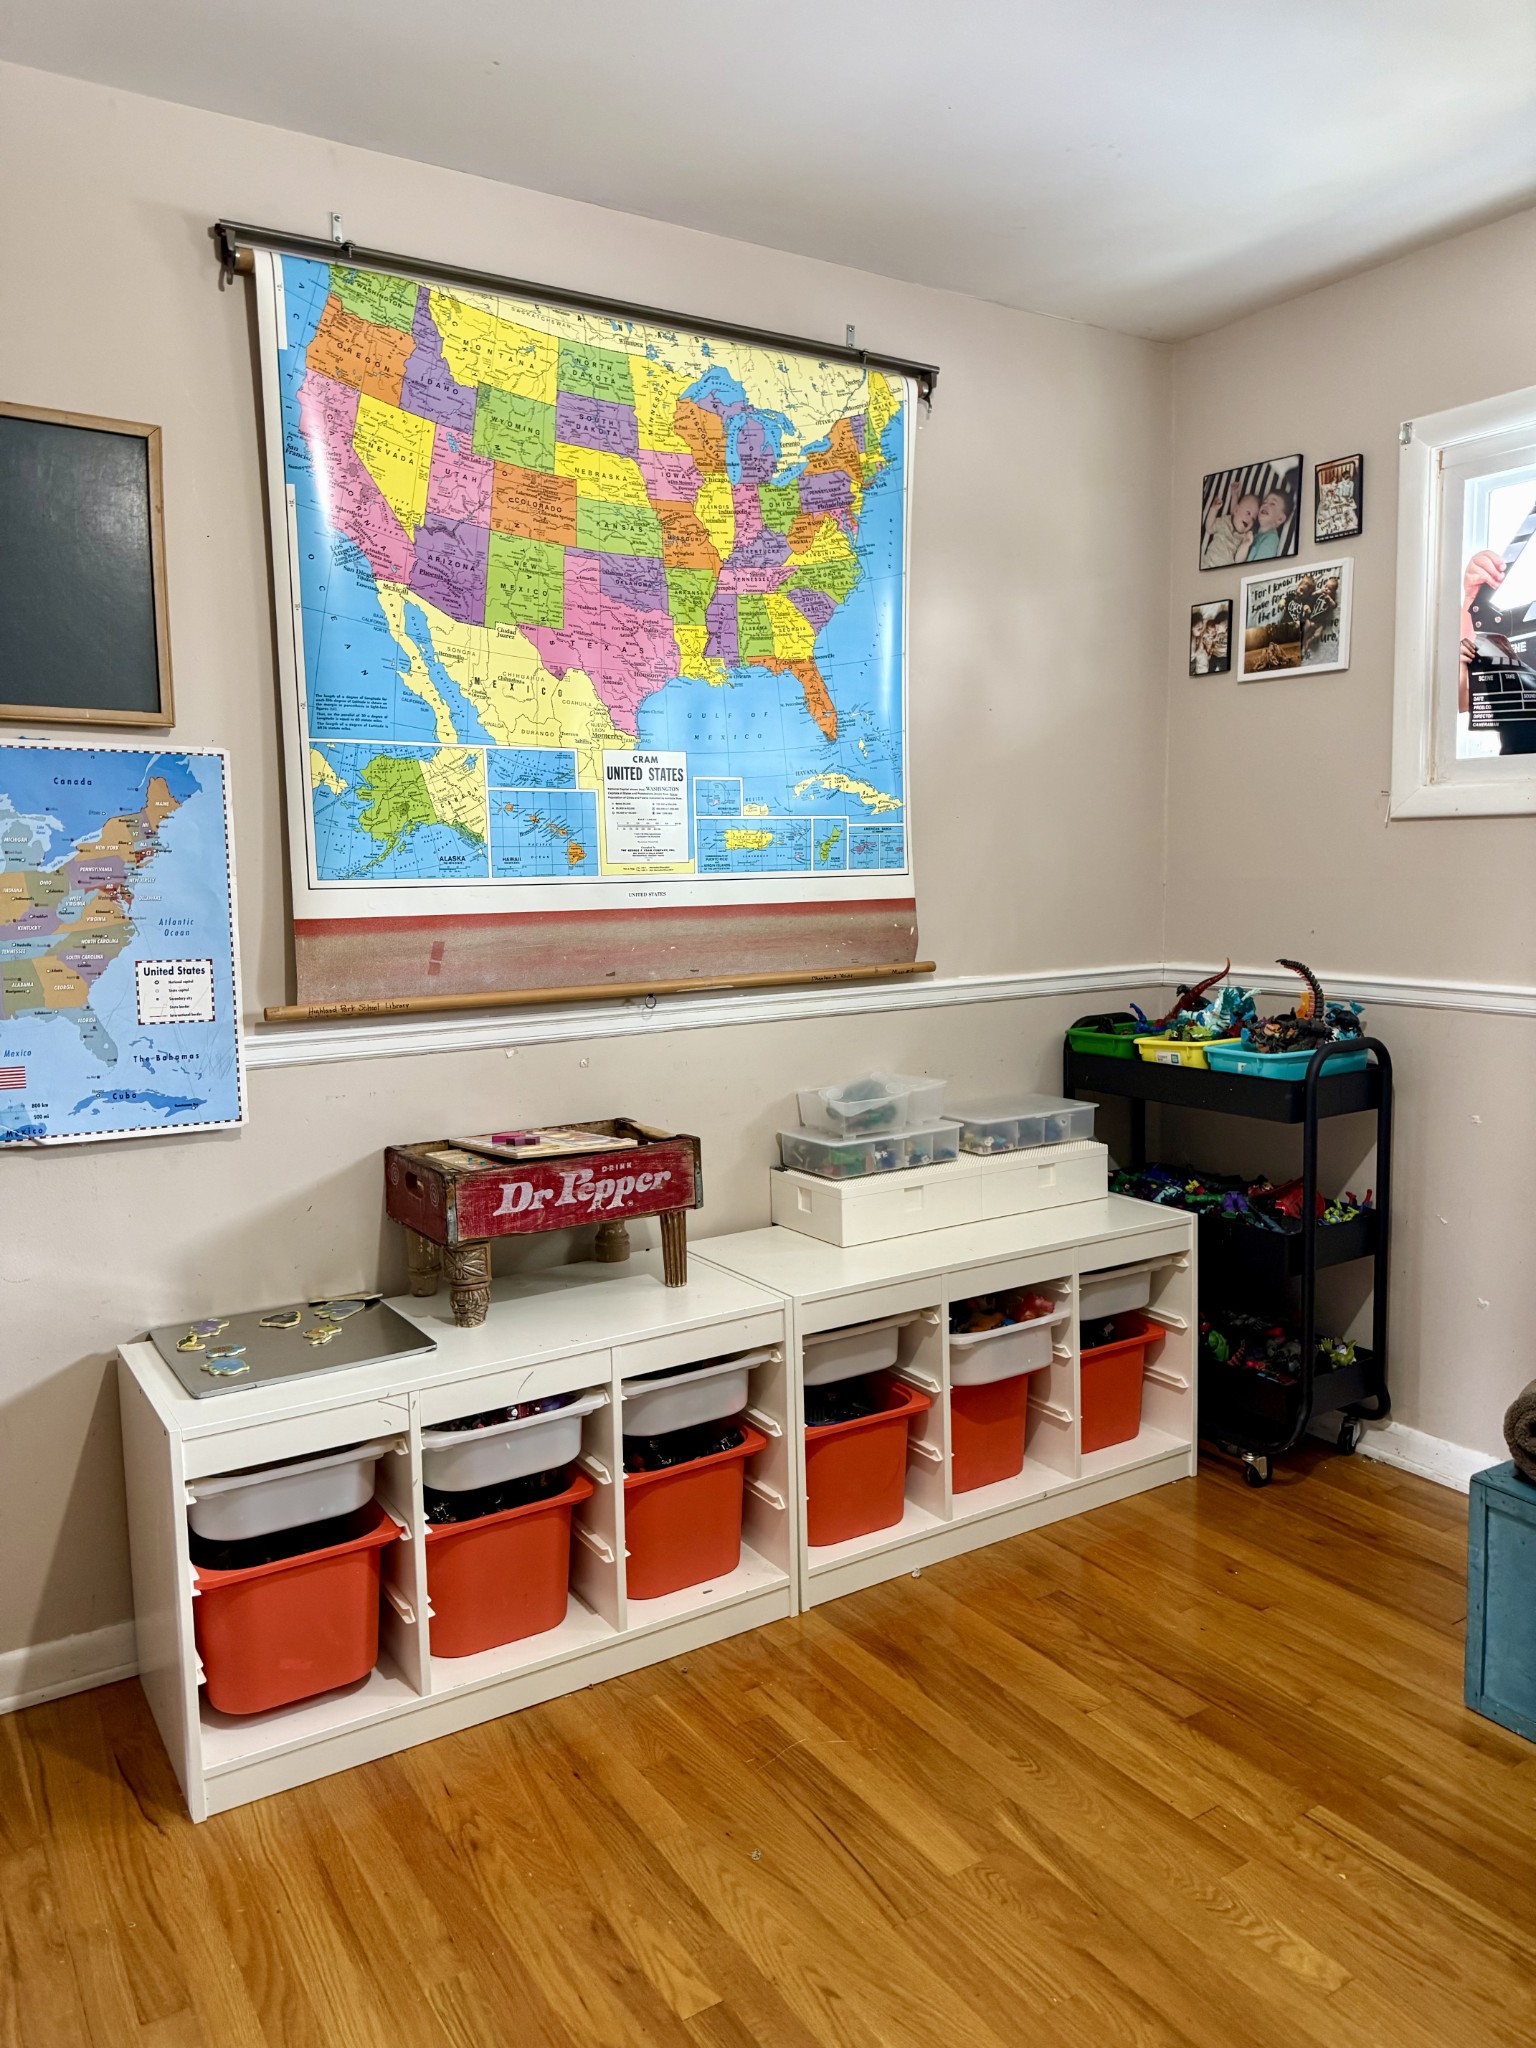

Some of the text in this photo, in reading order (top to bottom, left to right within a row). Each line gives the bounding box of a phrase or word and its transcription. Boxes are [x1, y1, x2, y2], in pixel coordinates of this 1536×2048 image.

[356, 282, 403, 308] WASHINGTON
[511, 306, 572, 329] SASKATCHEWAN
[337, 342, 390, 373] OREGON
[463, 339, 534, 369] MONTANA
[576, 357, 613, 372] NORTH
[572, 370, 616, 385] DAKOTA
[420, 375, 460, 396] IDAHO
[648, 380, 670, 436] MINNESOTA
[873, 402, 892, 411] MAINE
[491, 415, 541, 435] WYOMING
[579, 414, 614, 427] SOUTH
[575, 423, 618, 438] DAKOTA
[690, 408, 720, 459] WISCONSIN
[368, 442, 414, 465] NEVADA
[813, 461, 828, 469] NEW
[445, 468, 477, 483] UTAH
[574, 467, 628, 482] NEBRASKA
[514, 497, 562, 513] COLORADO
[596, 521, 643, 533] KANSAS
[806, 550, 836, 558] VIRGINIA
[428, 554, 476, 572] ARIZONA
[514, 560, 538, 570] NEW
[500, 583, 548, 596] MEXICO
[615, 579, 652, 589] OKLAHOMA
[1273, 578, 1293, 592] know
[447, 647, 476, 657] SONORA
[570, 639, 644, 655] TEXAS
[502, 671, 545, 682] CHIHUAHUA
[474, 677, 563, 698] MEXICO
[483, 720, 505, 728] SINALOA
[521, 729, 555, 737] DURANGO
[694, 733, 762, 741] MEXICO
[607, 766, 684, 781] UNITED STATES
[53, 777, 92, 786] Canada
[439, 854, 466, 862] ALASKA
[158, 918, 194, 926] Atlantic
[144, 966, 205, 976] United States
[340, 1005, 355, 1013] Park
[358, 1003, 380, 1012] School
[4, 1049, 32, 1058] Mexico
[156, 1053, 200, 1061] Bahamas
[112, 1092, 137, 1100] Cuba
[6, 1128, 43, 1138] Mexico
[601, 1161, 632, 1172] DRINK
[493, 1168, 672, 1217] Dr Pepper
